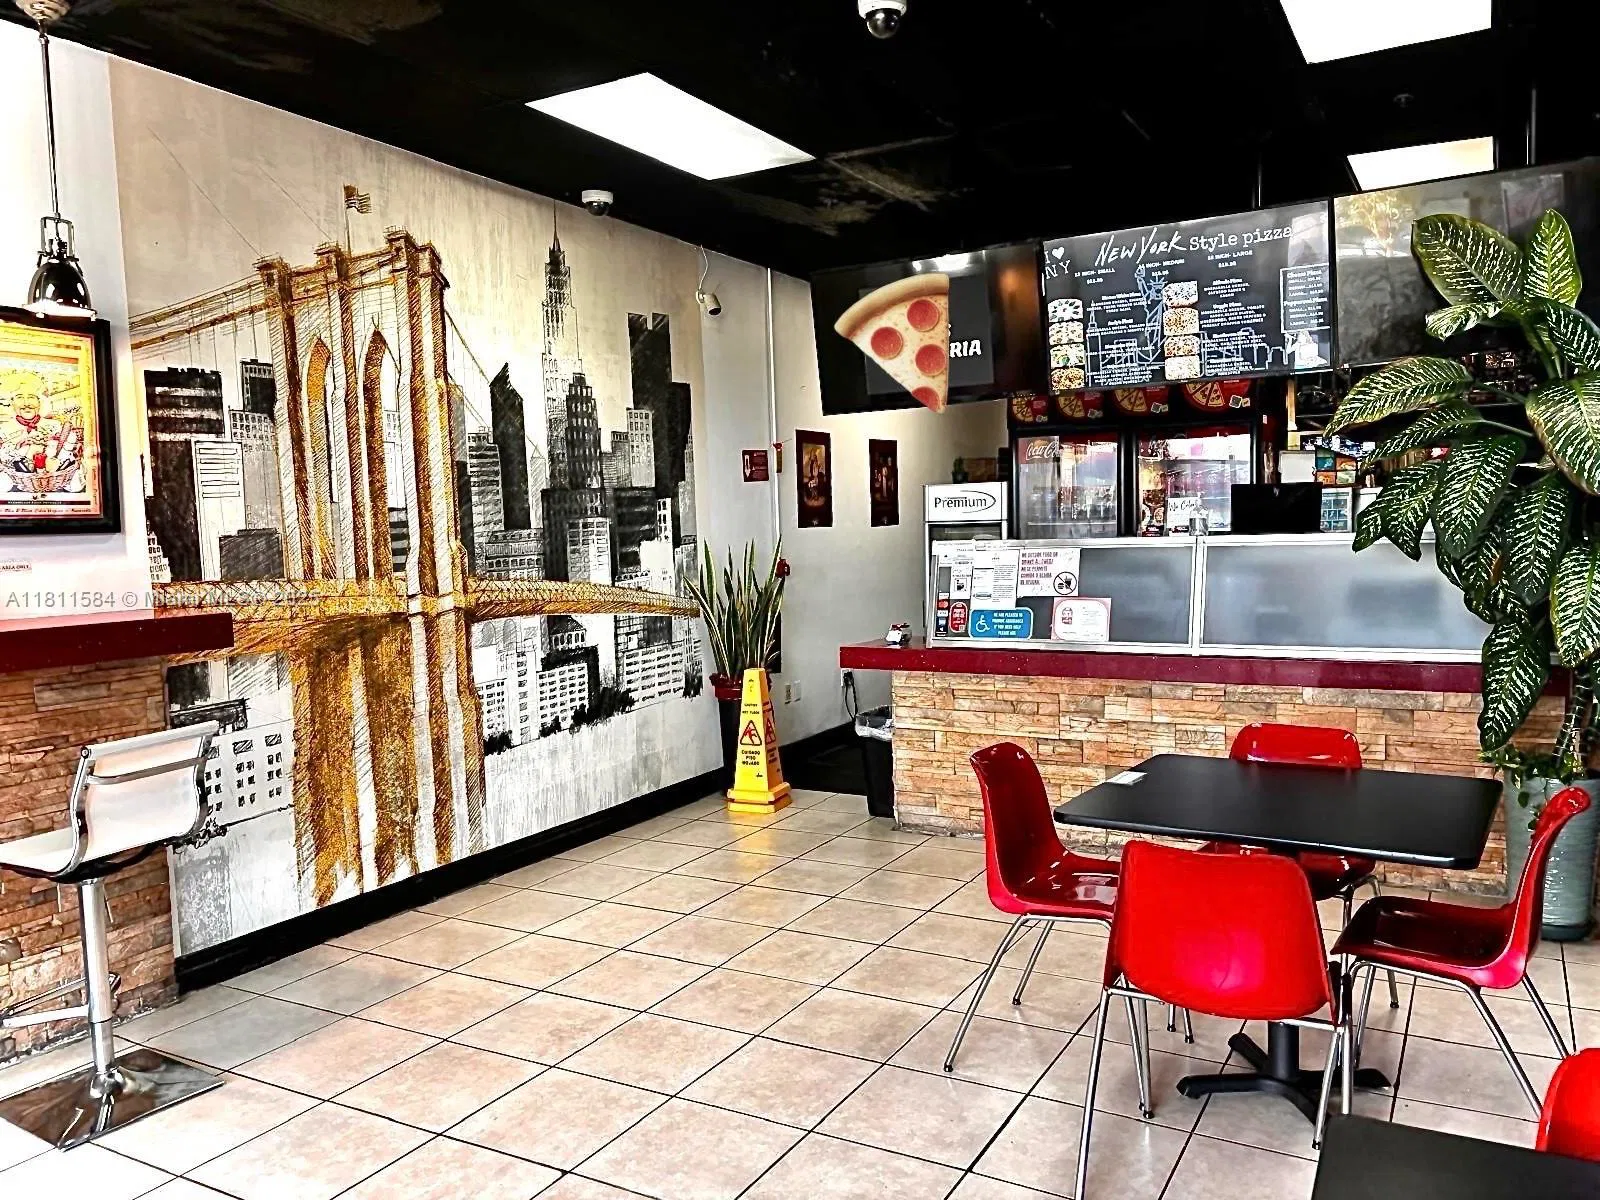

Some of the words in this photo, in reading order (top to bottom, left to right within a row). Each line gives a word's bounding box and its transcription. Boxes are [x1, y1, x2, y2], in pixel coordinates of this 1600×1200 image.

[1189, 232, 1239, 252] Style
[1241, 226, 1294, 248] pizza
[1044, 250, 1051, 264] I
[1232, 250, 1253, 258] LARGE
[1045, 259, 1071, 280] NY
[934, 496, 987, 508] Premium
